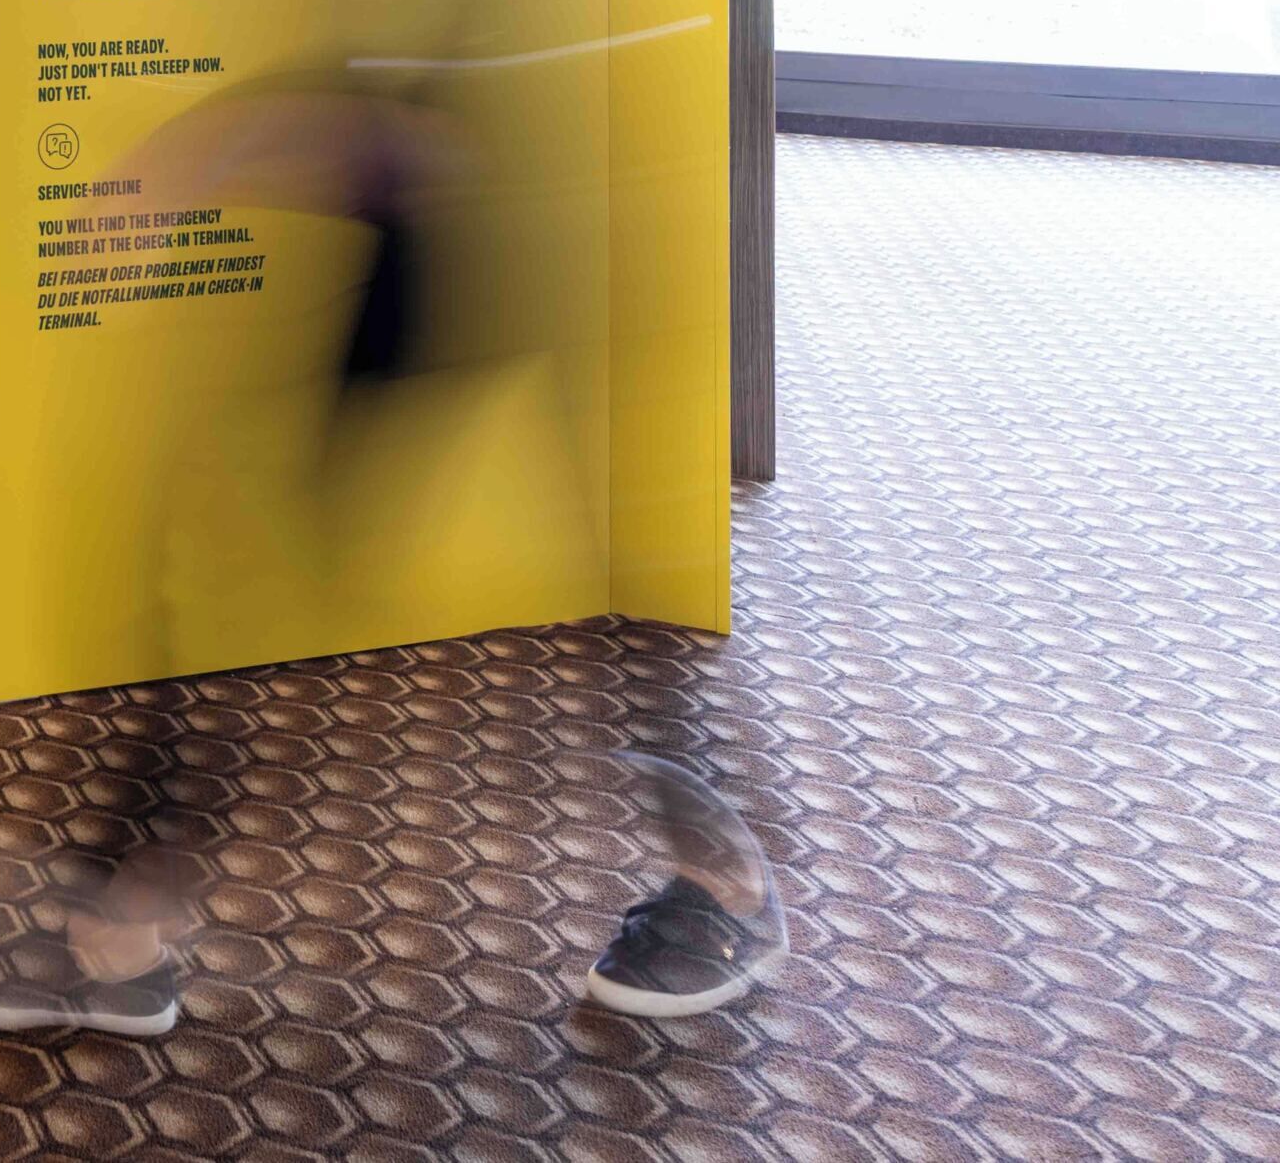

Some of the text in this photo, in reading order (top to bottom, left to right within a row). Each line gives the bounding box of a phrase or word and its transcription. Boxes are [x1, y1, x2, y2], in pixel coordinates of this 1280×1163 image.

[38, 38, 169, 61] NOW, YOU ARE READY.
[39, 57, 224, 81] JUST DON'T FALL ASLEEEP NOW.
[38, 85, 91, 102] NOT YET.
[38, 179, 142, 201] SERVICE-HOTLINE
[38, 208, 223, 236] YOU WILL FIND THE EMERGENCY
[38, 227, 254, 258] NUMBER AT THE CHECK-IN TERMINAL.
